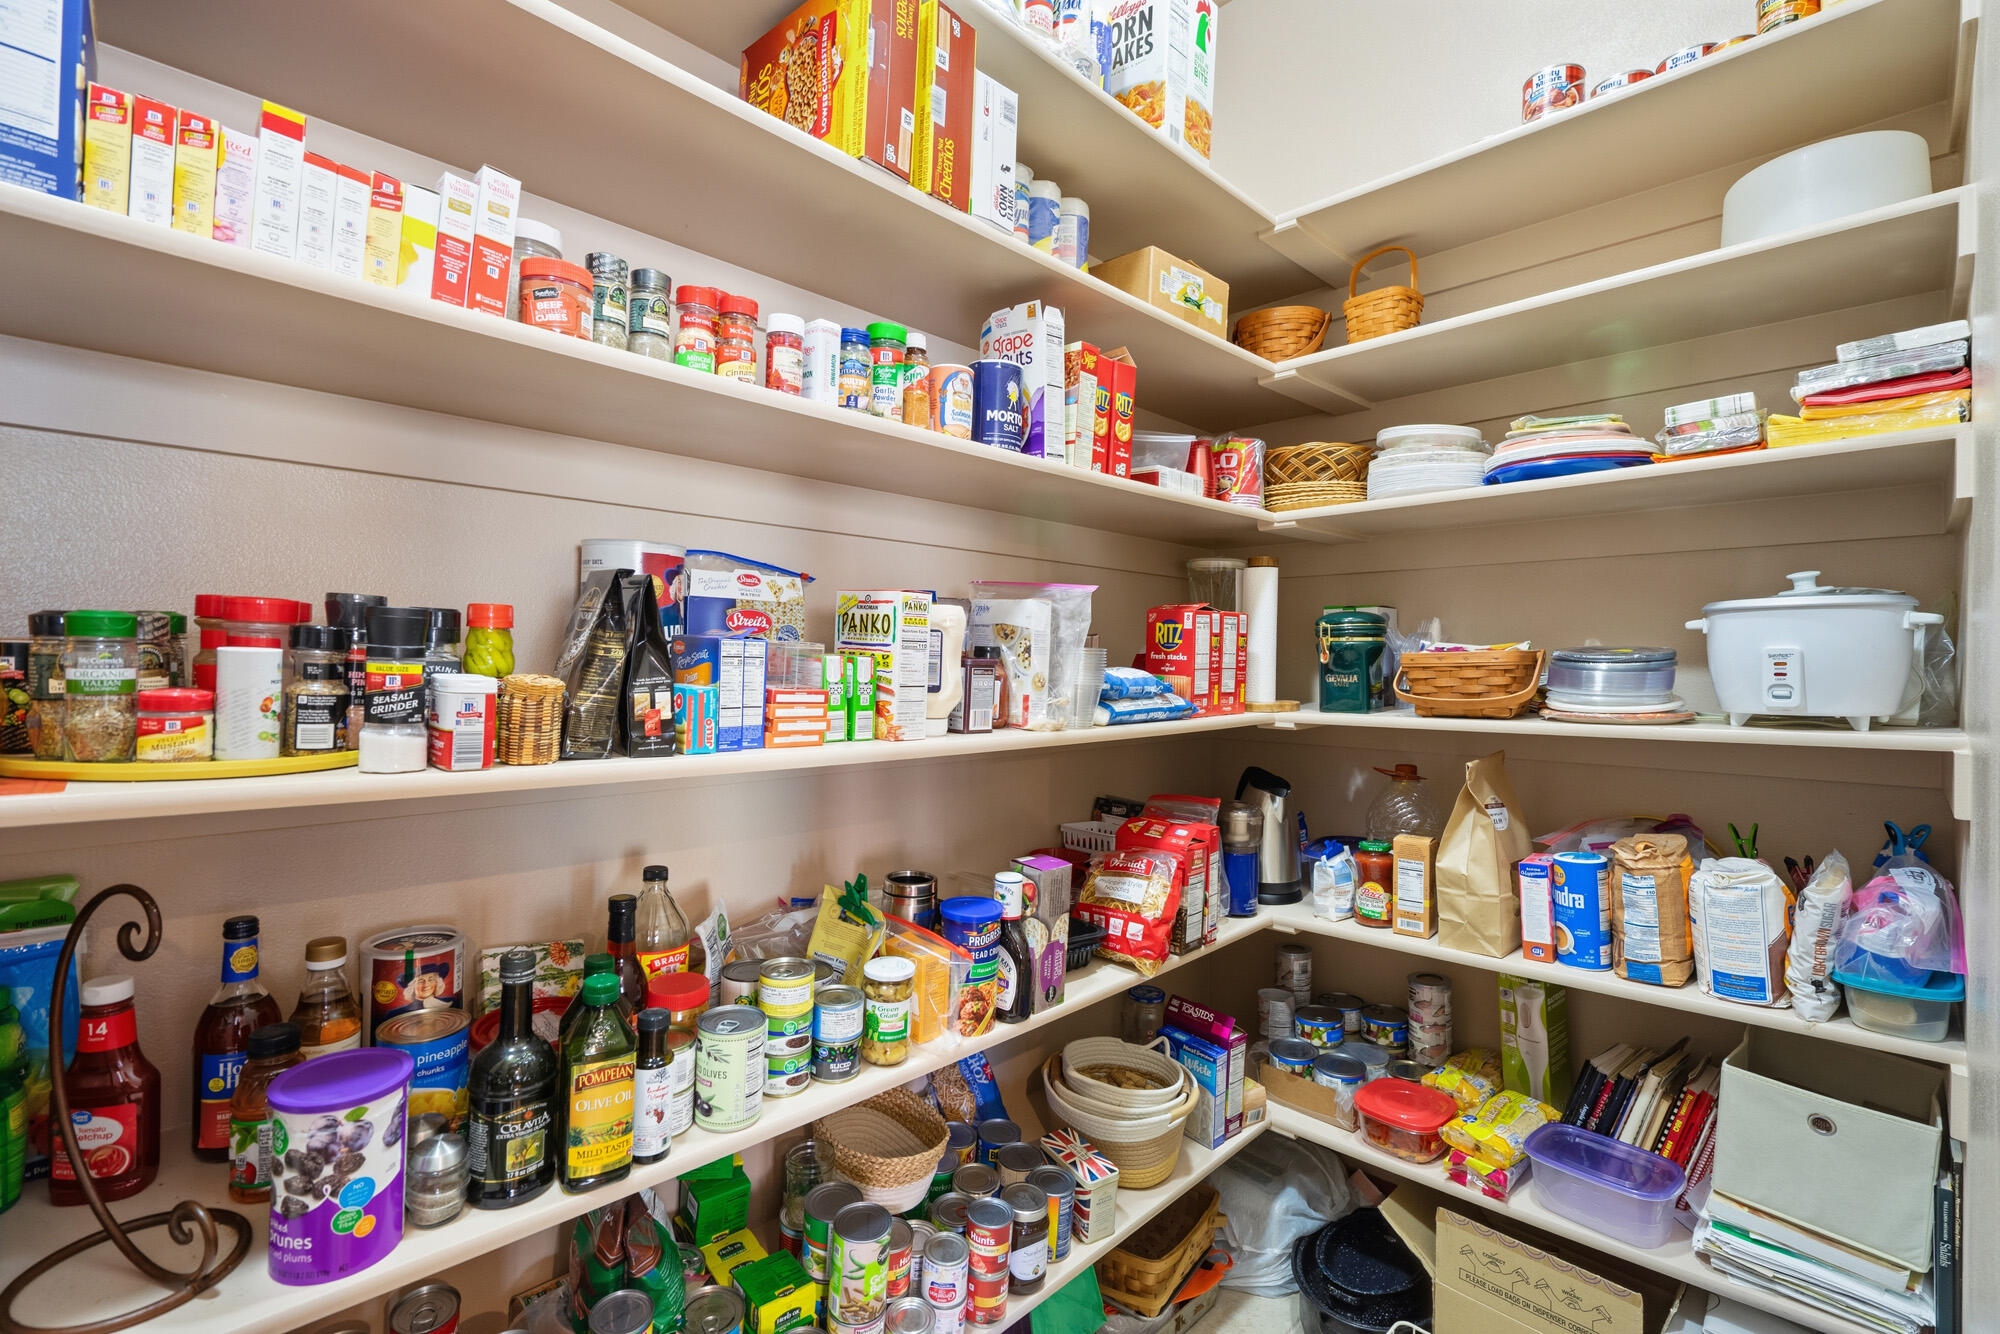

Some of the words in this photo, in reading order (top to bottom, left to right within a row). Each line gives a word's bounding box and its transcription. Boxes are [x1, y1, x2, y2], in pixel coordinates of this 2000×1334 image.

[1111, 5, 1153, 49] ORN
[821, 19, 830, 91] CHOLESTEROL
[1112, 33, 1154, 70] AKES
[821, 92, 830, 133] LOWER
[224, 139, 251, 157] Red
[939, 138, 955, 198] Cheerios
[449, 183, 475, 199] Vanilla
[487, 181, 515, 200] Vanilla
[998, 184, 1008, 218] CORN
[536, 301, 563, 310] BEEF
[536, 313, 568, 322] CUBES
[993, 332, 1034, 359] grape
[873, 393, 896, 402] Powder
[874, 386, 896, 395] Garlic
[1116, 391, 1134, 415] RITZ
[986, 409, 1022, 427] MORTO
[1003, 423, 1019, 433] SALT
[904, 600, 928, 612] PANKO
[728, 611, 770, 629] Streit's
[841, 612, 891, 635] PANKO
[1155, 622, 1183, 644] RITZ
[78, 656, 124, 666] McCormick
[1150, 652, 1166, 660] fresh
[1167, 652, 1188, 661] stacks
[73, 670, 129, 680] ORGANIC
[425, 665, 458, 675] ATKINS
[1325, 673, 1359, 683] GEVALIA
[373, 694, 391, 705] SEA
[391, 691, 415, 702] SALT
[370, 699, 419, 715] GRINDER
[151, 737, 196, 751] Mustard
[1554, 886, 1585, 909] ndra
[1820, 902, 1837, 929] SUGAR
[969, 928, 1001, 947] PROGRES
[1816, 928, 1831, 955] BROWN
[654, 953, 687, 968] BRAGG
[813, 951, 834, 962] Nutrition
[972, 949, 988, 960] READ
[1813, 952, 1827, 978] LIGHT
[877, 1005, 899, 1013] Green
[1181, 1002, 1214, 1022] TOASTEDS
[87, 1021, 108, 1038] 14
[417, 1039, 468, 1066] pineapple
[416, 1065, 445, 1077] chunks
[829, 1062, 852, 1070] SLICED
[1183, 1055, 1212, 1078] White
[577, 1063, 634, 1088] POMPEIAN
[703, 1070, 728, 1081] OLIVES
[575, 1096, 613, 1112] OLIVE
[615, 1090, 634, 1103] OIL
[78, 1126, 106, 1134] Tomato
[500, 1111, 550, 1134] COLAVITA
[77, 1131, 113, 1142] etchup
[576, 1146, 603, 1160] MILD
[604, 1140, 631, 1153] TASTE
[283, 1252, 313, 1263] plums
[1482, 1252, 1506, 1266] CORRECT
[1939, 1241, 1951, 1267] Salads
[1561, 1287, 1583, 1303] WRONG
[1465, 1274, 1487, 1292] PLEASE
[1487, 1283, 1505, 1299] LOAD
[1504, 1290, 1522, 1307] BAGS
[1521, 1298, 1532, 1310] ON
[1532, 1303, 1567, 1327] DISPENSER
[1567, 1319, 1600, 1334] CORRE
